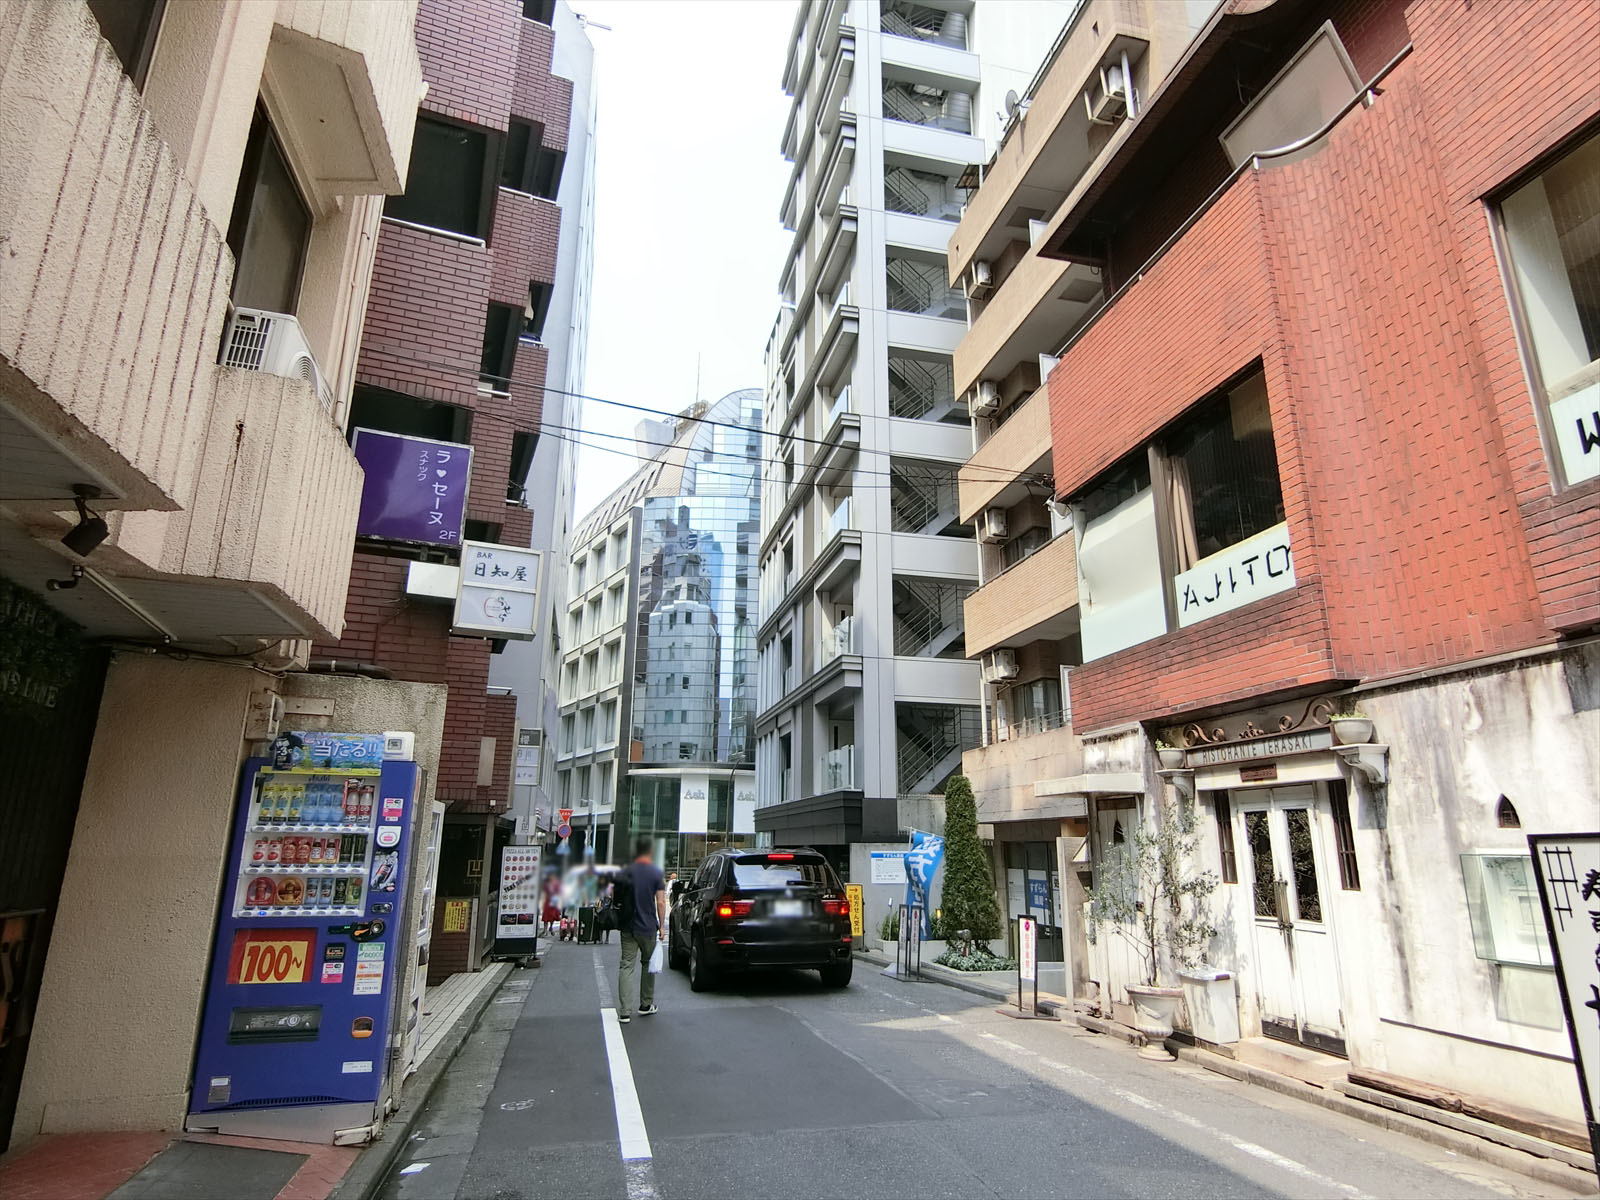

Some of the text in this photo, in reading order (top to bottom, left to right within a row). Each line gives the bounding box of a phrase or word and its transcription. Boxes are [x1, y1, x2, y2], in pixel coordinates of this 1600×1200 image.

[417, 449, 429, 481] スナック
[439, 529, 457, 540] 2F
[477, 551, 493, 559] BAR
[474, 562, 527, 582] 日知屋
[314, 740, 377, 757] 当たる!!
[1202, 733, 1313, 763] RISTORANTE TERASAKI
